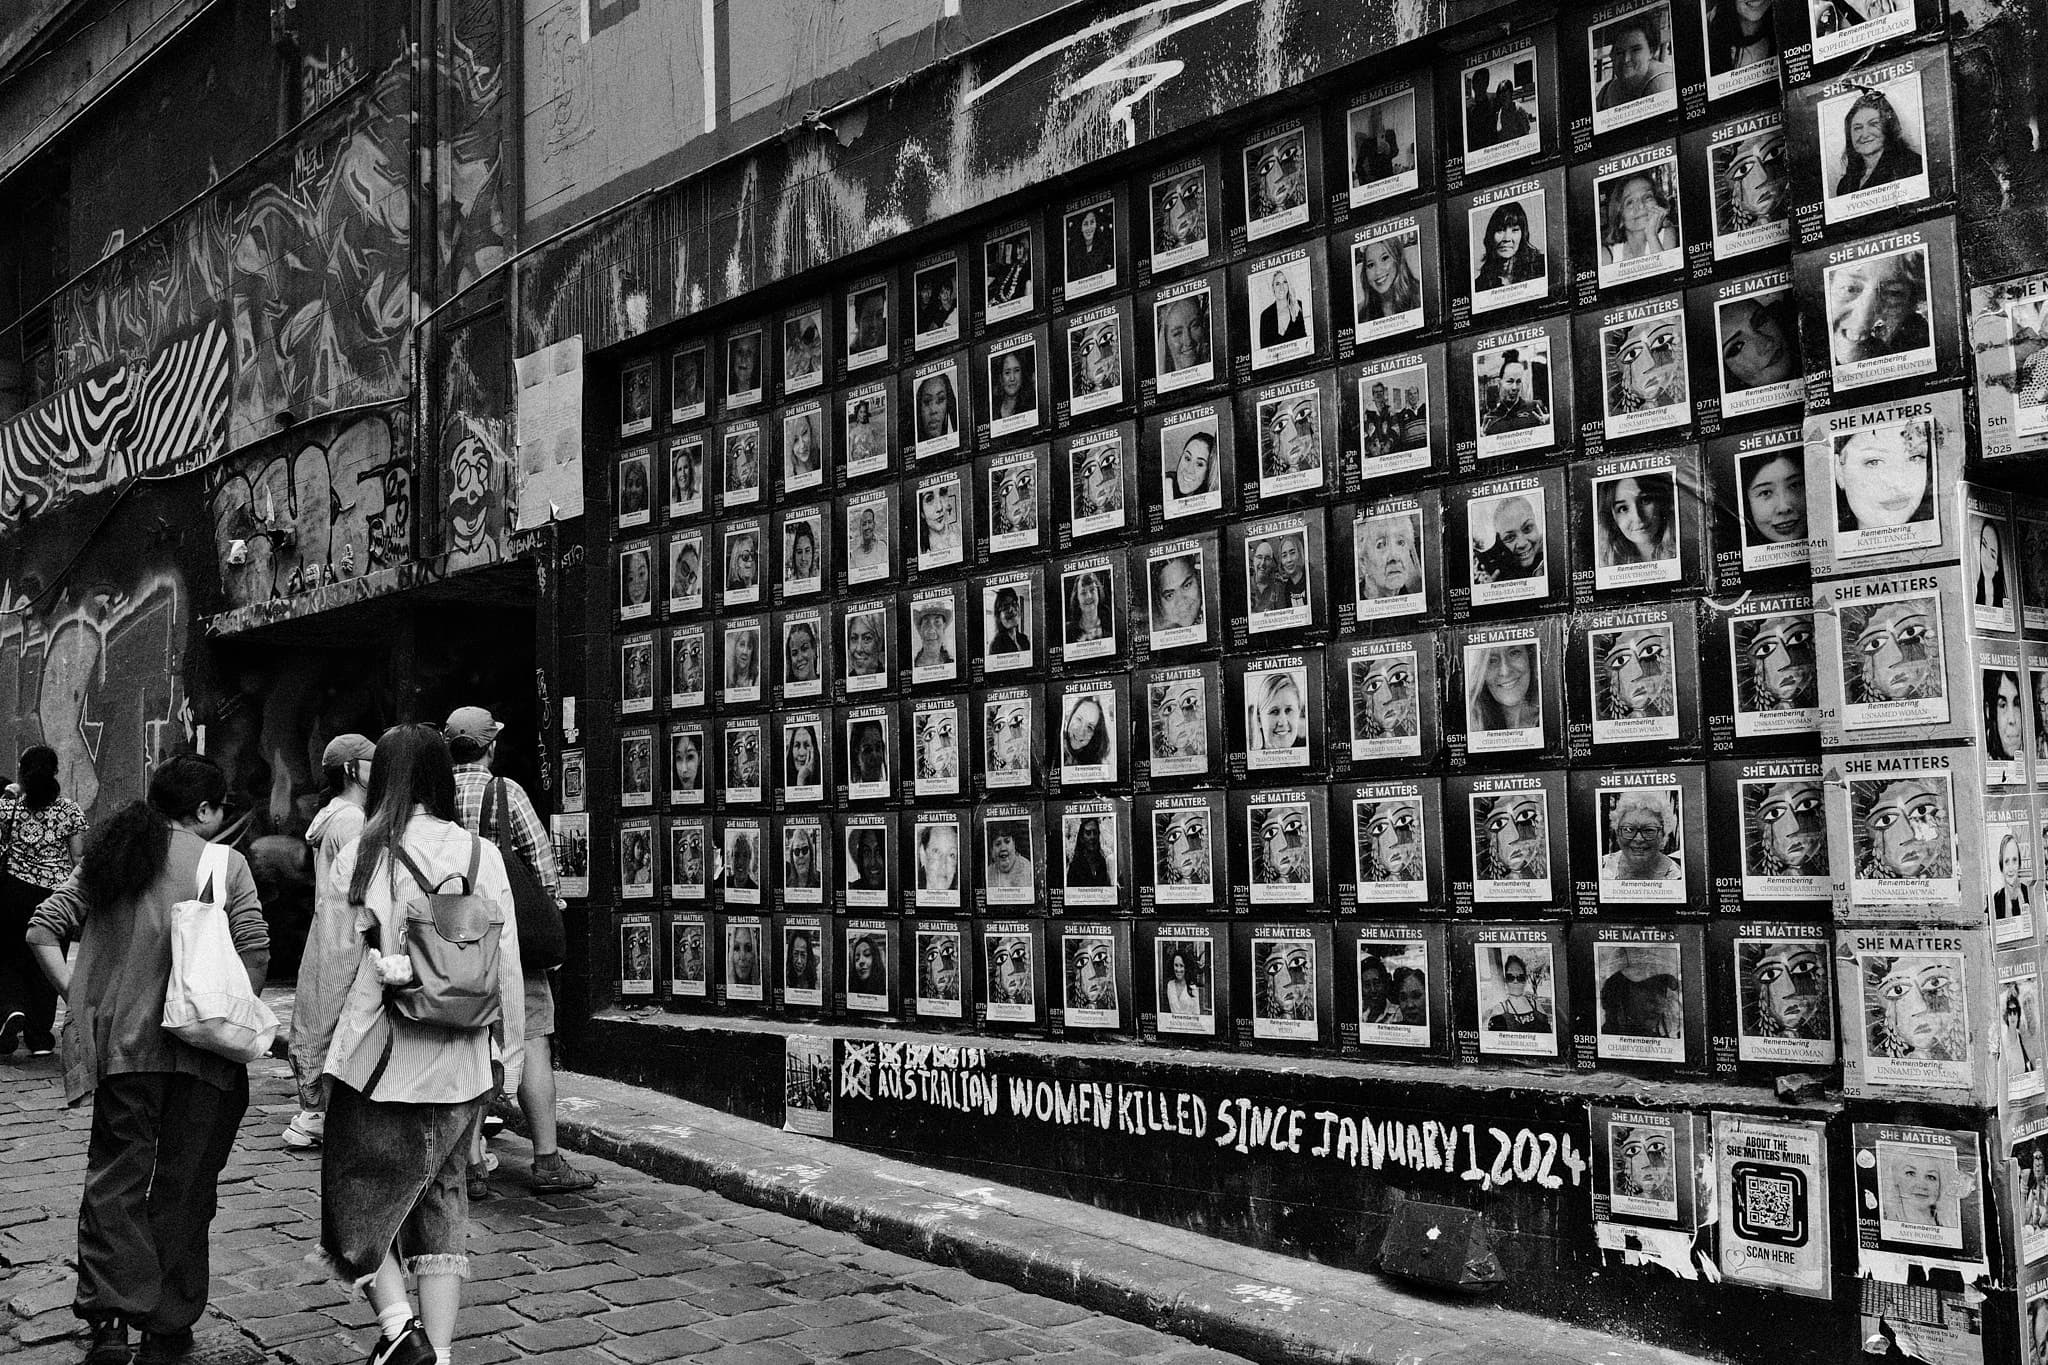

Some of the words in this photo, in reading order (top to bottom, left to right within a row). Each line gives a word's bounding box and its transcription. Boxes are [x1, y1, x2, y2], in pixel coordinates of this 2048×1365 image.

[1838, 16, 1887, 38] Remembering
[1465, 52, 1490, 67] THEY
[1492, 38, 1532, 57] MATTER
[1783, 43, 1812, 58] 102ND
[1730, 58, 1774, 78] Remembering
[1762, 66, 1778, 79] MAS
[1789, 71, 1812, 84] 2024
[1823, 81, 1850, 98] SHE
[1851, 60, 1914, 90] MATTERS
[1681, 82, 1706, 97] 99TH
[1686, 107, 1706, 120] 2024
[1712, 126, 1733, 142] SHE
[1599, 161, 1619, 175] SHE
[1622, 146, 1673, 169] MATTERS
[1473, 193, 1491, 207] SHE
[1494, 180, 1540, 200] MATTERS
[1851, 182, 1900, 201] Remembering
[1795, 202, 1823, 216] 101ST
[1737, 222, 1782, 238] Remembering
[1801, 231, 1824, 244] 2024
[1688, 241, 1712, 254] 98TH
[1829, 249, 1853, 264] SHE
[1858, 232, 1921, 256] MATTERS
[1251, 260, 1266, 272] SHE
[1268, 249, 1306, 267] MATTERS
[1576, 270, 1595, 282] 26th
[1693, 267, 1713, 279] 2024
[1719, 284, 1742, 298] SHE
[1745, 272, 1792, 293] MATTER
[1579, 295, 1597, 306] 2024
[1604, 312, 1624, 326] SHE
[1627, 299, 1679, 320] MATTERS
[1857, 353, 1907, 368] Remembering
[915, 368, 927, 378] SHE
[927, 359, 954, 375] MATTERS
[1836, 370, 1864, 384] KRISTY
[1865, 364, 1896, 379] LOUISE
[1897, 358, 1933, 372] HUNTER
[1745, 383, 1790, 397] Remembering
[1696, 398, 1719, 410] 97TH
[1830, 416, 1857, 430] SHE
[1862, 402, 1932, 425] MATTERS
[1987, 416, 2007, 427] 5th
[1700, 424, 1721, 435] 2024
[1739, 437, 1762, 451] SHE
[1766, 429, 1802, 446] MATT
[1987, 444, 2012, 456] 2025
[1597, 464, 1617, 476] SHE
[1620, 456, 1671, 473] MATTERS
[1860, 525, 1911, 538] Remembering
[1766, 541, 1809, 552] Rememberin
[1857, 535, 1881, 547] KATIE
[1716, 551, 1741, 562] 96TH
[1721, 578, 1742, 587] 2024
[1835, 587, 1861, 599] SHE
[1867, 577, 1938, 594] MATTERS
[1734, 603, 1756, 615] SHE
[1760, 597, 1811, 612] MATTER
[1593, 616, 1614, 629] SHE
[1616, 611, 1667, 626] MATTERS
[1247, 660, 1262, 671] SHE
[1264, 657, 1303, 668] MATTERS
[1868, 699, 1919, 710] Remembering
[1709, 715, 1733, 725] 95TH
[1759, 709, 1805, 719] Remembering
[1713, 741, 1733, 751] 2024
[1822, 736, 1839, 745] 025
[1846, 760, 1872, 772] SHE
[1877, 756, 1950, 771] MATTERS
[1743, 766, 1766, 777] SHE
[1473, 781, 1491, 791] SHE
[1494, 778, 1541, 790] MATTERS
[1600, 776, 1621, 786] SHE
[1624, 774, 1676, 785] MATTERS
[917, 814, 929, 823] SHE
[930, 813, 957, 822] MATTERS
[1453, 882, 1472, 890] 78TH
[1576, 882, 1597, 891] 79TH
[1716, 878, 1741, 887] 80TH
[1766, 877, 1813, 885] Remembering
[1878, 879, 1929, 888] Remembering
[1456, 906, 1472, 914] 2024
[1579, 906, 1598, 915] 2024
[1721, 904, 1741, 913] 2024
[849, 919, 859, 928] SHE
[860, 920, 886, 929] MATTERS
[1599, 930, 1619, 940] SHE
[1622, 930, 1676, 941] MATTERS
[1739, 926, 1762, 937] SHE
[1766, 926, 1823, 937] MATTERS
[1857, 938, 1884, 950] SHE
[1891, 938, 1961, 950] MATTERS
[1712, 1037, 1737, 1046] 94TH
[1763, 1038, 1810, 1048] Remembering
[1792, 1049, 1824, 1058] WOMAN
[1716, 1064, 1737, 1073] 2024
[1891, 1059, 1942, 1069] Remembering
[879, 1069, 998, 1115] AUSTRALIAN
[1009, 1076, 1111, 1129] WOMEN
[1118, 1084, 1207, 1137] KILLED
[1215, 1098, 1305, 1154] SINCE
[1312, 1112, 1457, 1173] JANUARY
[1612, 1112, 1628, 1122] SHE
[1630, 1115, 1670, 1126] MATTERS
[1746, 1136, 1770, 1150] ABOUT
[1774, 1138, 1787, 1151] THE
[1880, 1131, 1900, 1141] SHE
[1903, 1132, 1951, 1144] MATTERS
[1727, 1145, 1742, 1157] SHE
[1744, 1146, 1780, 1161] MATTERS
[1782, 1151, 1811, 1166] MURAL
[1859, 1218, 1879, 1226] 104TH
[1862, 1241, 1879, 1249] 2024
[1746, 1246, 1769, 1260] SCAN
[1772, 1250, 1795, 1264] HERE
